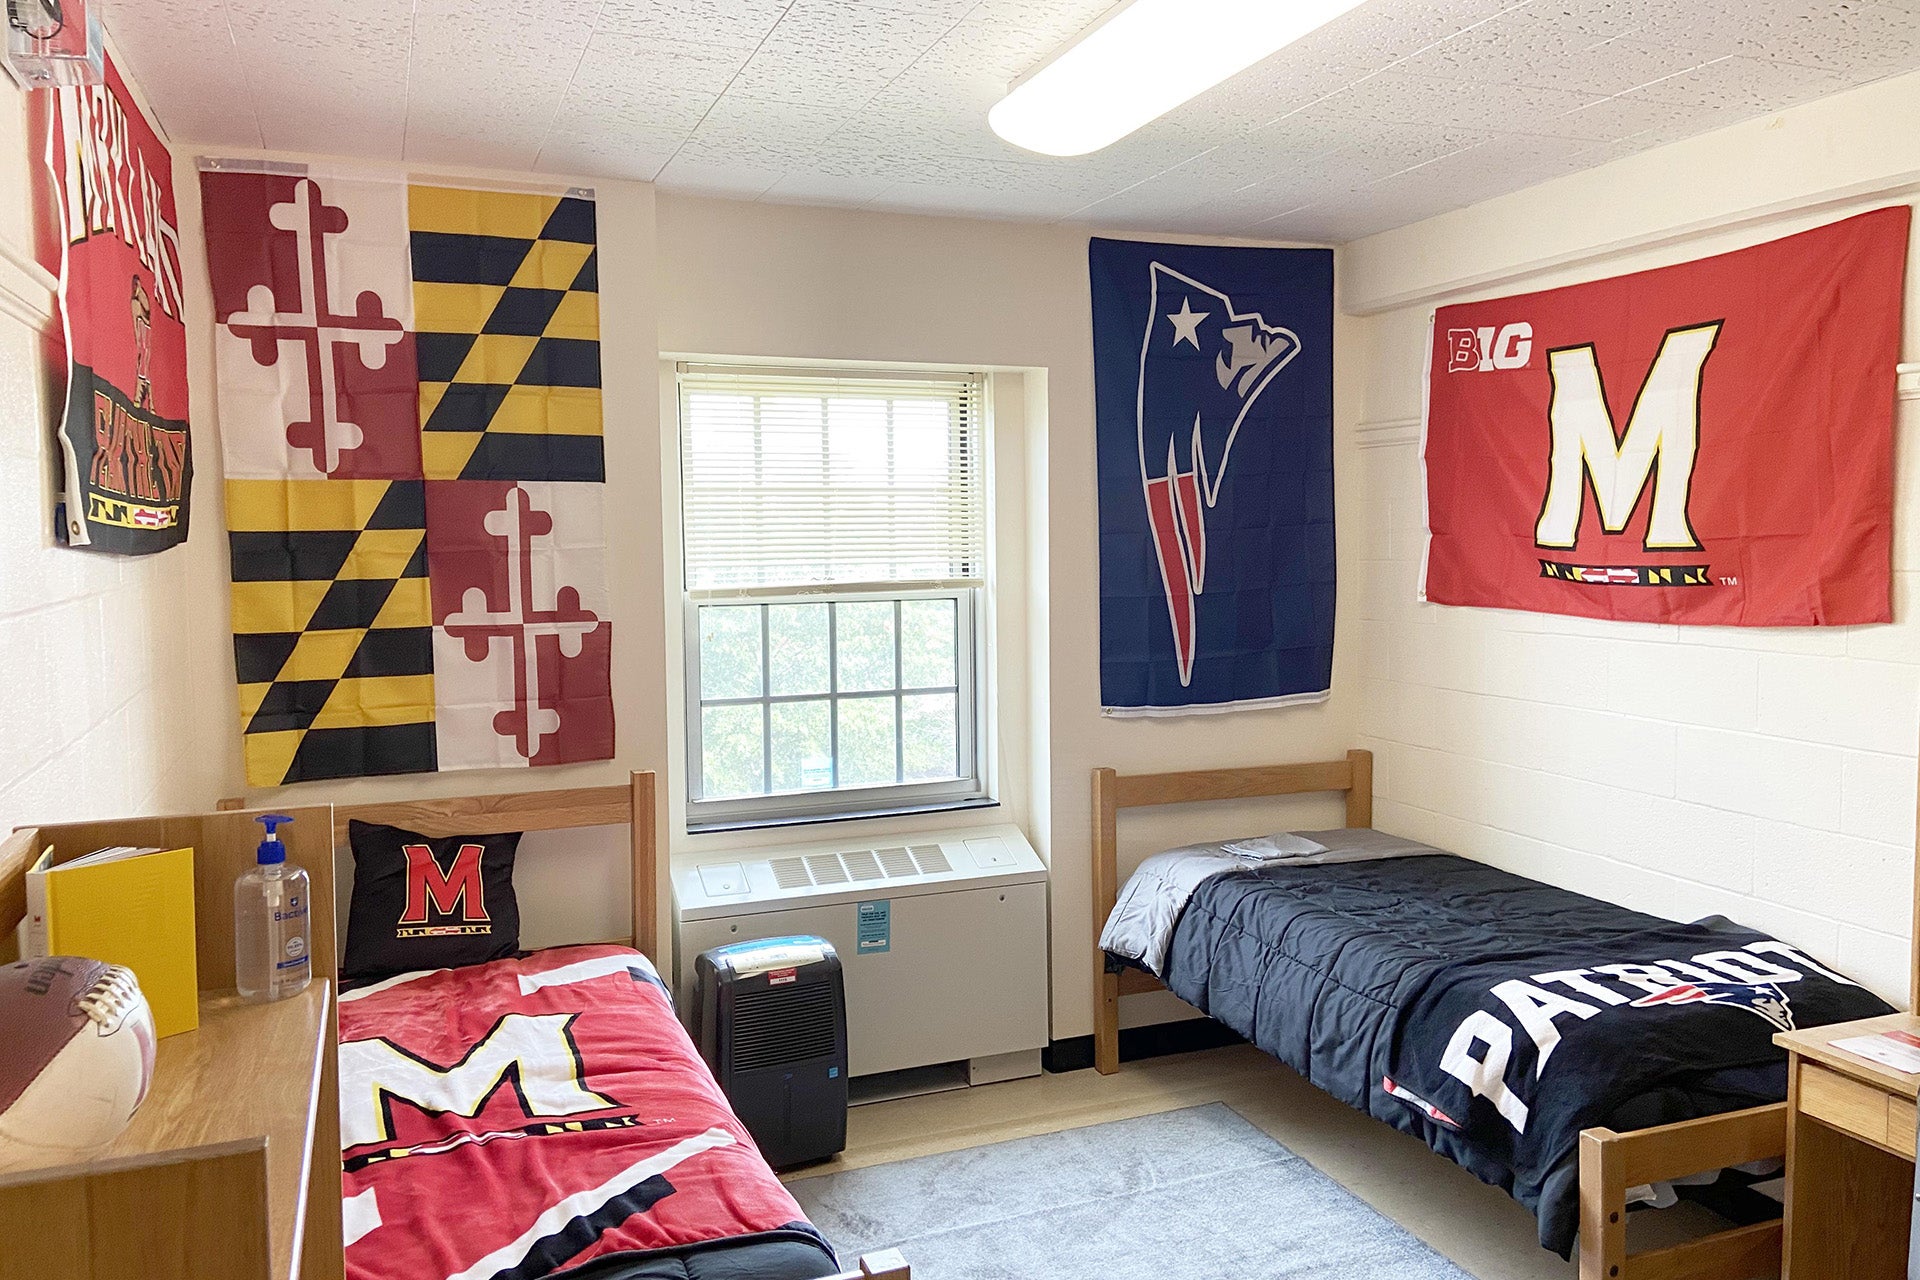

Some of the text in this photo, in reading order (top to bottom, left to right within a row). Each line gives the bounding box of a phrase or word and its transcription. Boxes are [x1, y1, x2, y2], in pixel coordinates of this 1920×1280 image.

[1534, 318, 1725, 553] M
[1719, 577, 1738, 586] TM
[398, 843, 491, 925] M
